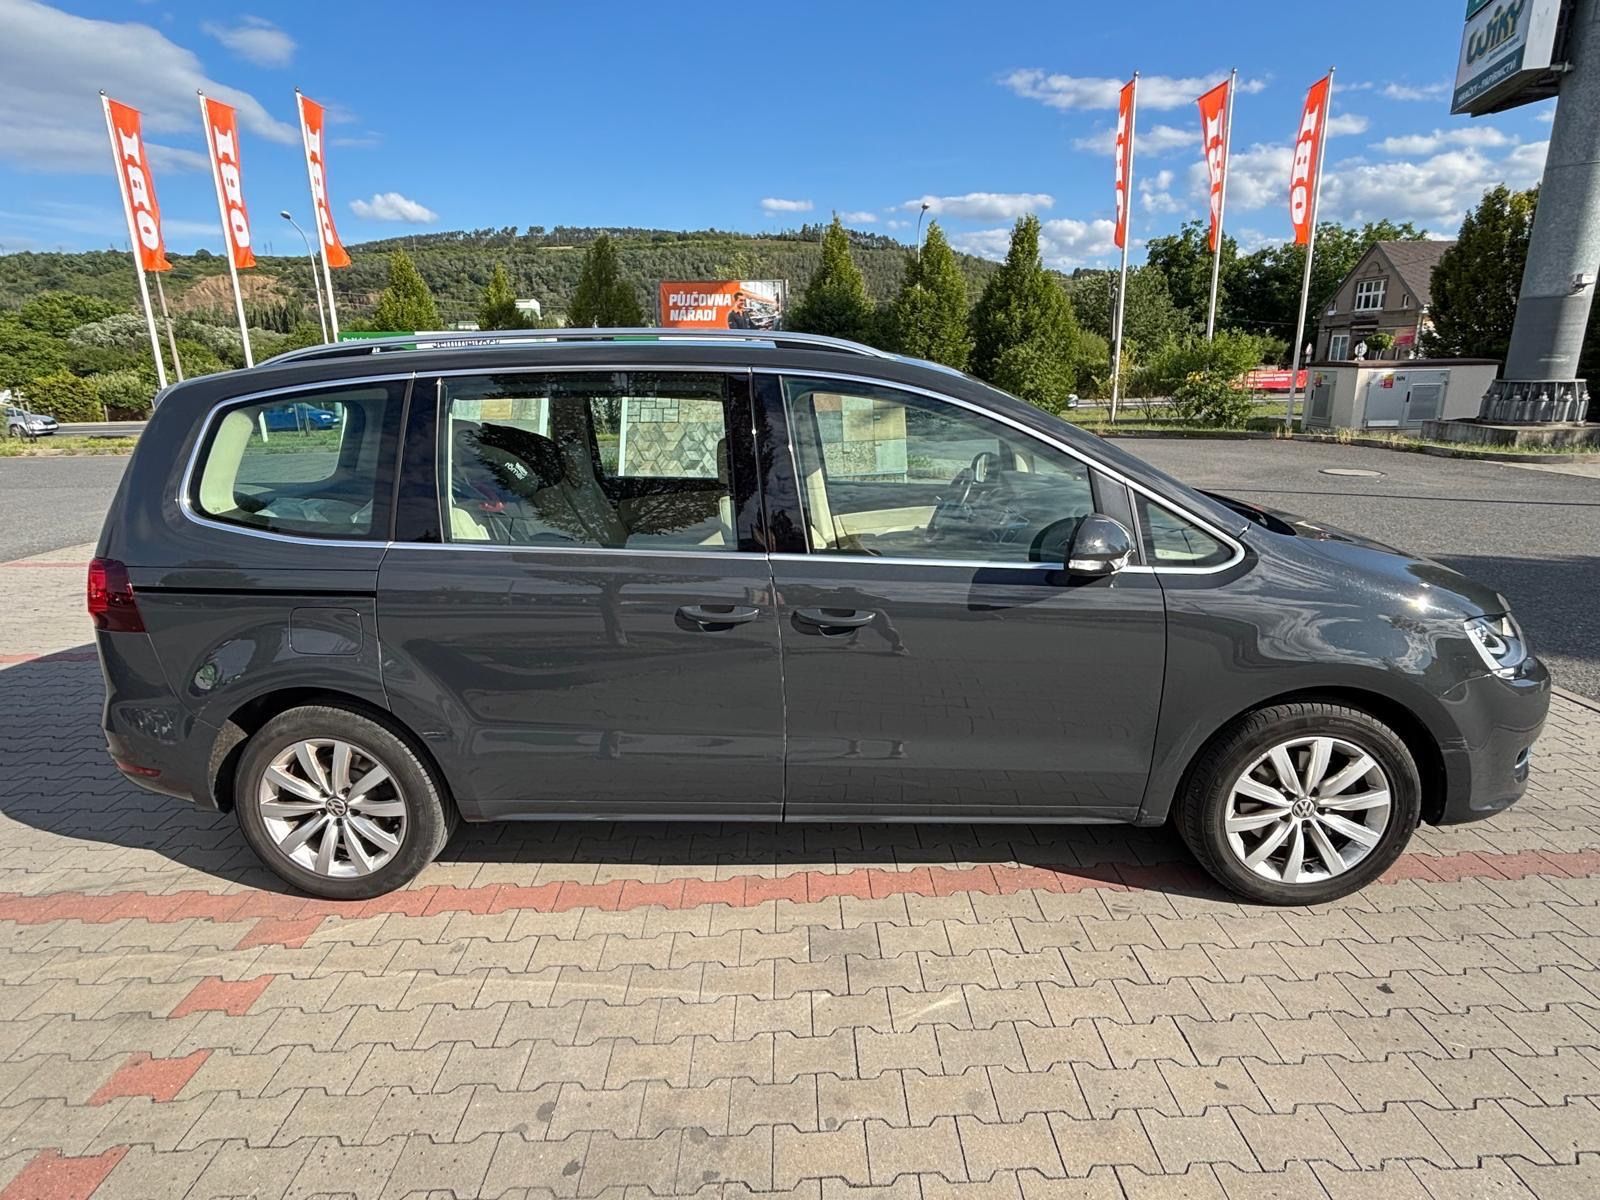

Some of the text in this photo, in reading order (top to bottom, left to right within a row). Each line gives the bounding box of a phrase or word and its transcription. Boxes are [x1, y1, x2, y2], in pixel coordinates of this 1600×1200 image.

[118, 126, 160, 251] OBI
[213, 124, 250, 248] OBI
[1291, 104, 1319, 225] OBI
[668, 291, 732, 307] PŮJČOVNA
[669, 307, 717, 321] NÁŘADÍ
